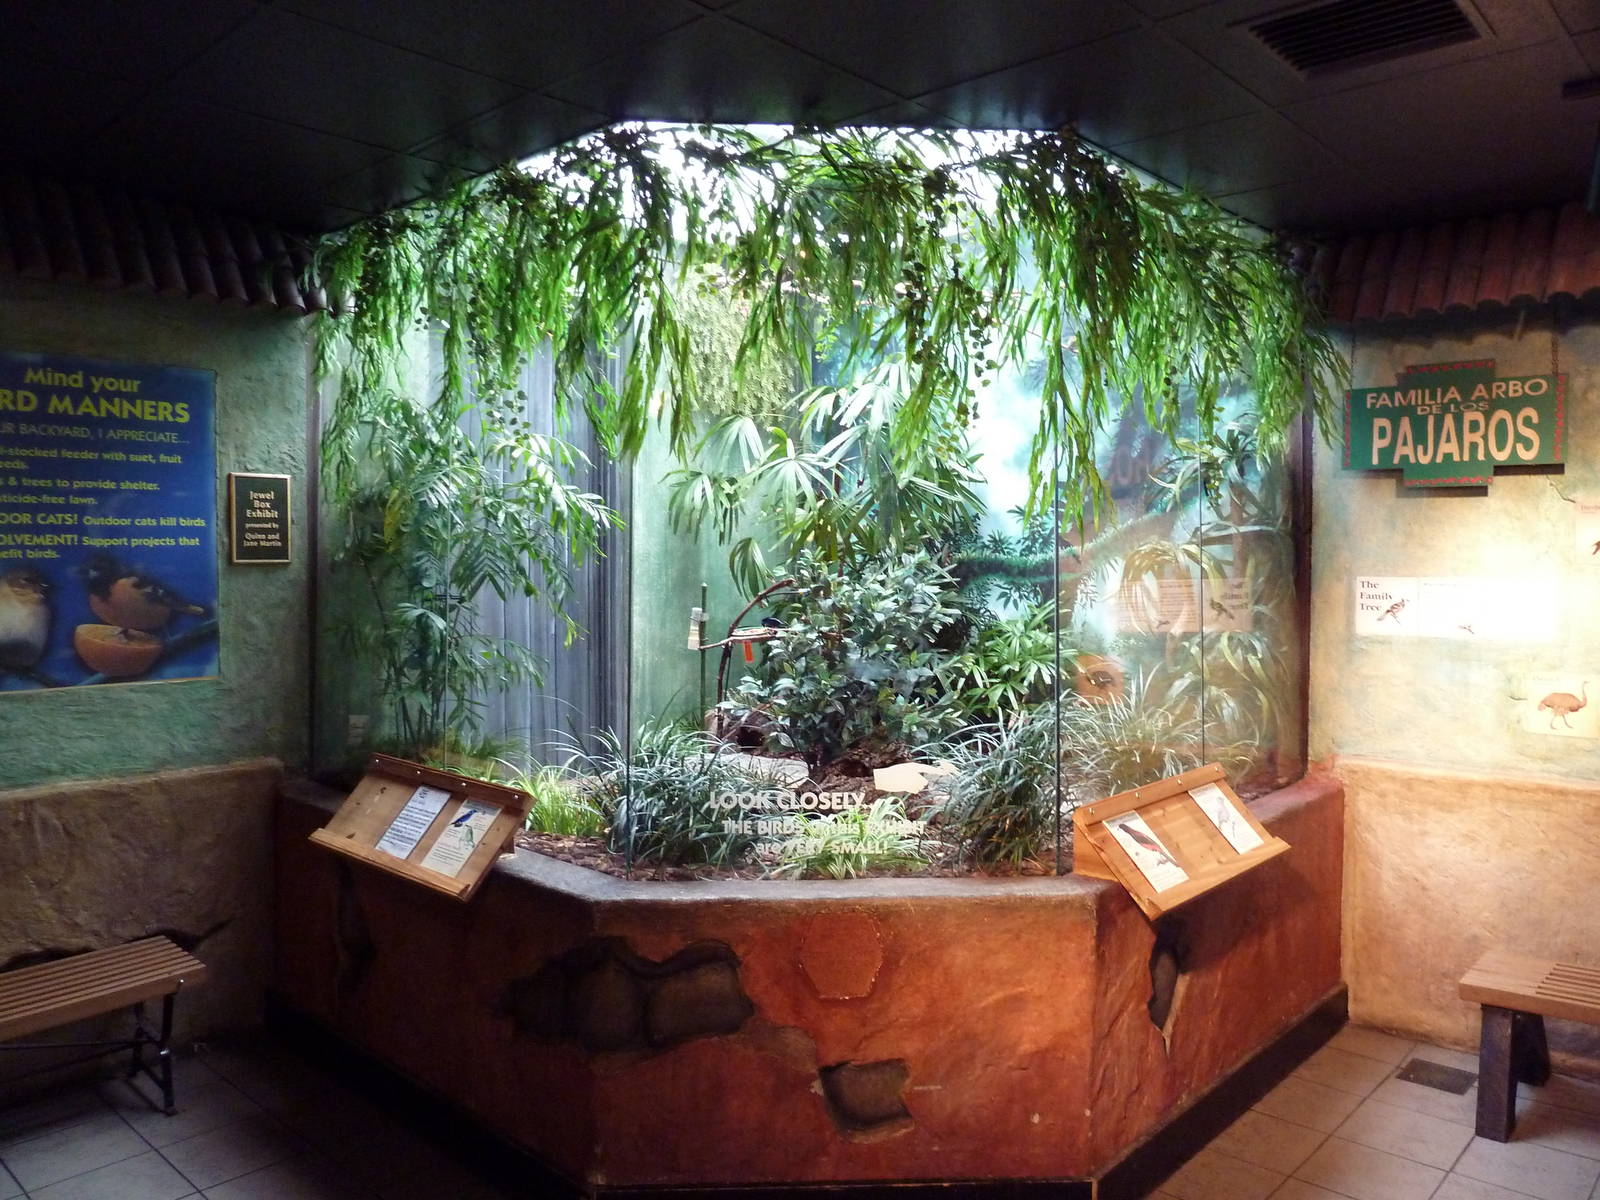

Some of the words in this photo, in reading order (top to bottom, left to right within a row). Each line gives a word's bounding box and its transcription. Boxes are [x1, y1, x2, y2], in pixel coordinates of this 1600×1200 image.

[24, 368, 83, 387] Mind
[89, 375, 142, 393] your
[1366, 386, 1462, 409] FAMILIA
[1470, 378, 1549, 400] ARBO
[48, 394, 190, 423] MANNERS
[1416, 404, 1442, 416] DE
[1450, 401, 1490, 413] LOS
[1372, 407, 1541, 465] PAJAROS
[61, 448, 98, 459] feeder
[102, 452, 126, 461] with
[129, 454, 156, 464] suet,
[159, 453, 182, 464] fruit
[8, 476, 17, 487] &
[22, 477, 53, 487] trees
[57, 479, 70, 488] to
[73, 480, 116, 489] provide
[120, 481, 160, 491] shelter.
[69, 495, 98, 505] lawn.
[250, 491, 274, 500] Jewel
[253, 500, 271, 508] Box
[37, 513, 78, 525] CATS!
[83, 516, 131, 526] Outdoor
[135, 517, 157, 527] cats
[160, 516, 177, 527] kill
[246, 509, 279, 518] Exhibit
[83, 536, 128, 548] Support
[131, 537, 176, 547] projects
[179, 537, 200, 546] that
[267, 532, 280, 540] and
[26, 549, 60, 559] birds.
[1360, 580, 1379, 589] The
[1360, 591, 1393, 602] Family
[1360, 602, 1382, 611] Tree
[710, 791, 770, 809] LOOK
[721, 819, 753, 834] THE
[831, 840, 888, 854] SMALL!
